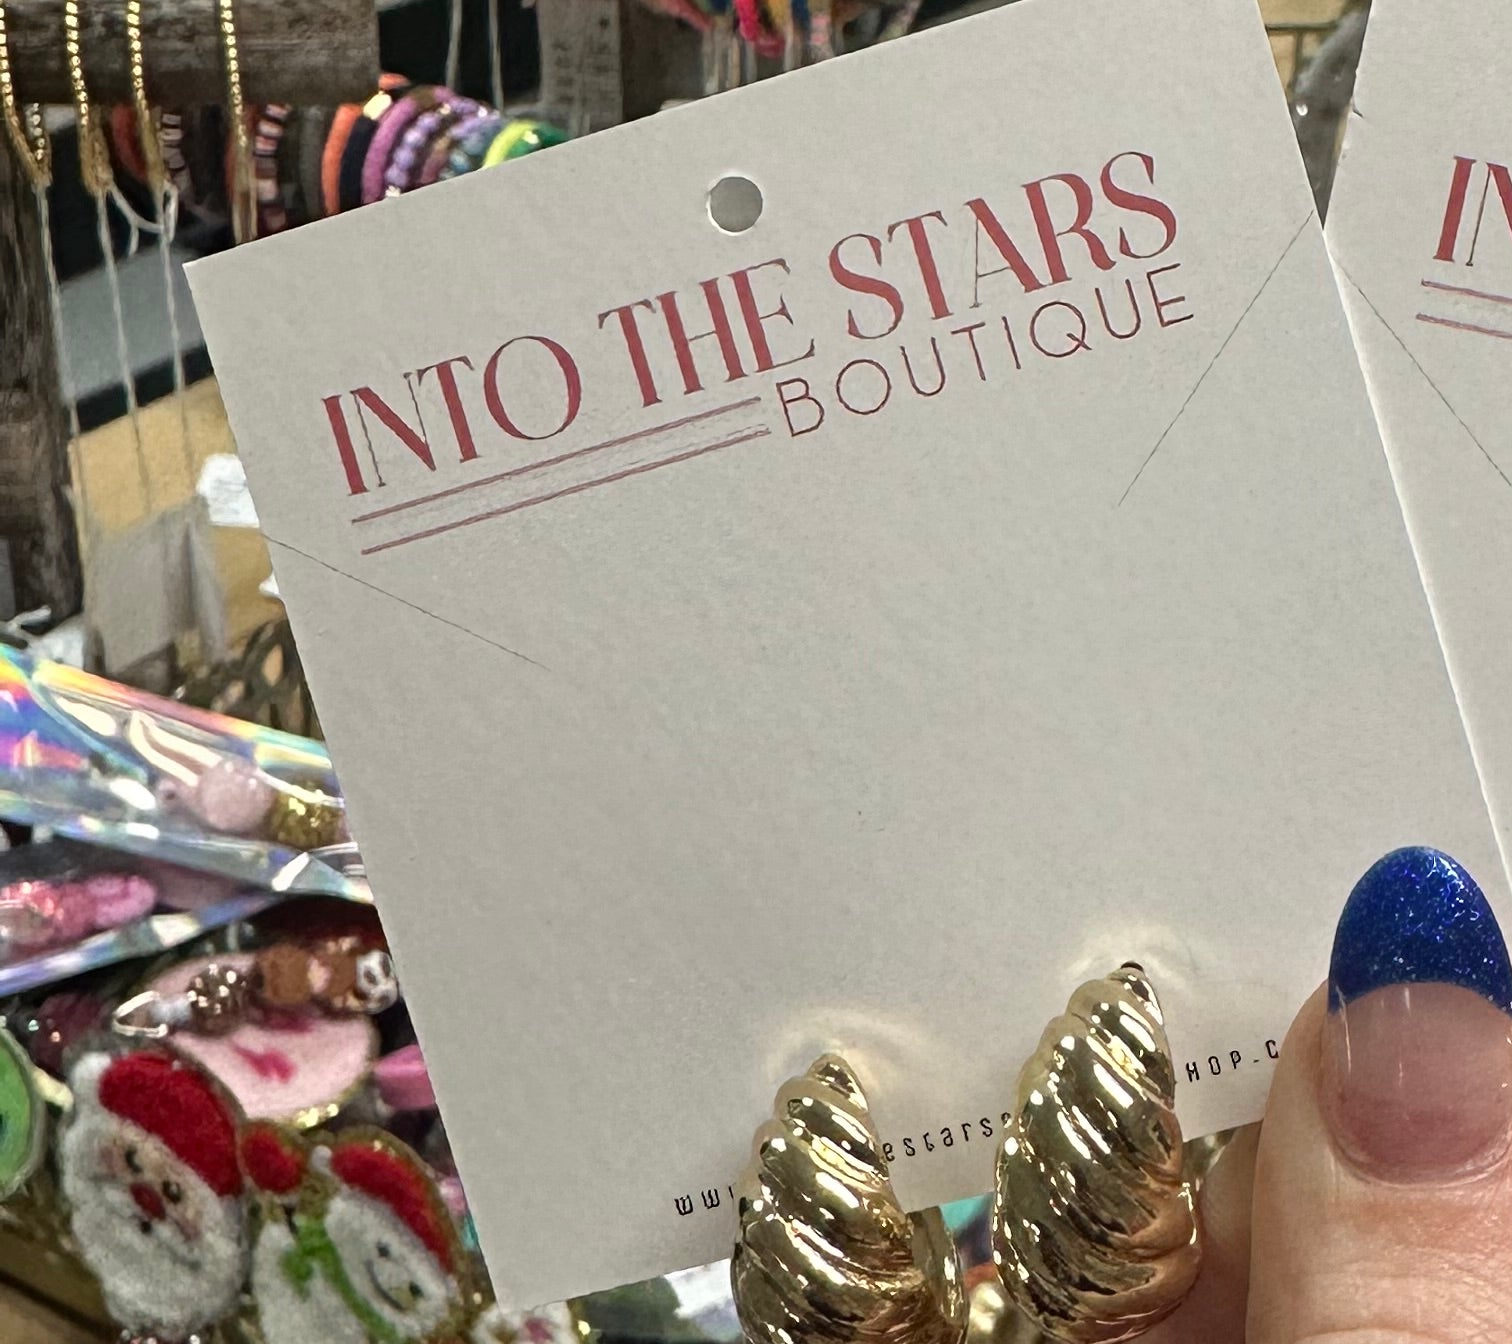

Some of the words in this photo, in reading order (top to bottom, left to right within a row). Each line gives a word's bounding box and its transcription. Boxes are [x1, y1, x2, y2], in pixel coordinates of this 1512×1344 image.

[321, 335, 582, 495] INTO
[598, 259, 815, 406] THE
[827, 151, 1181, 340] STARS
[776, 263, 1194, 437] BOUTIQUE
